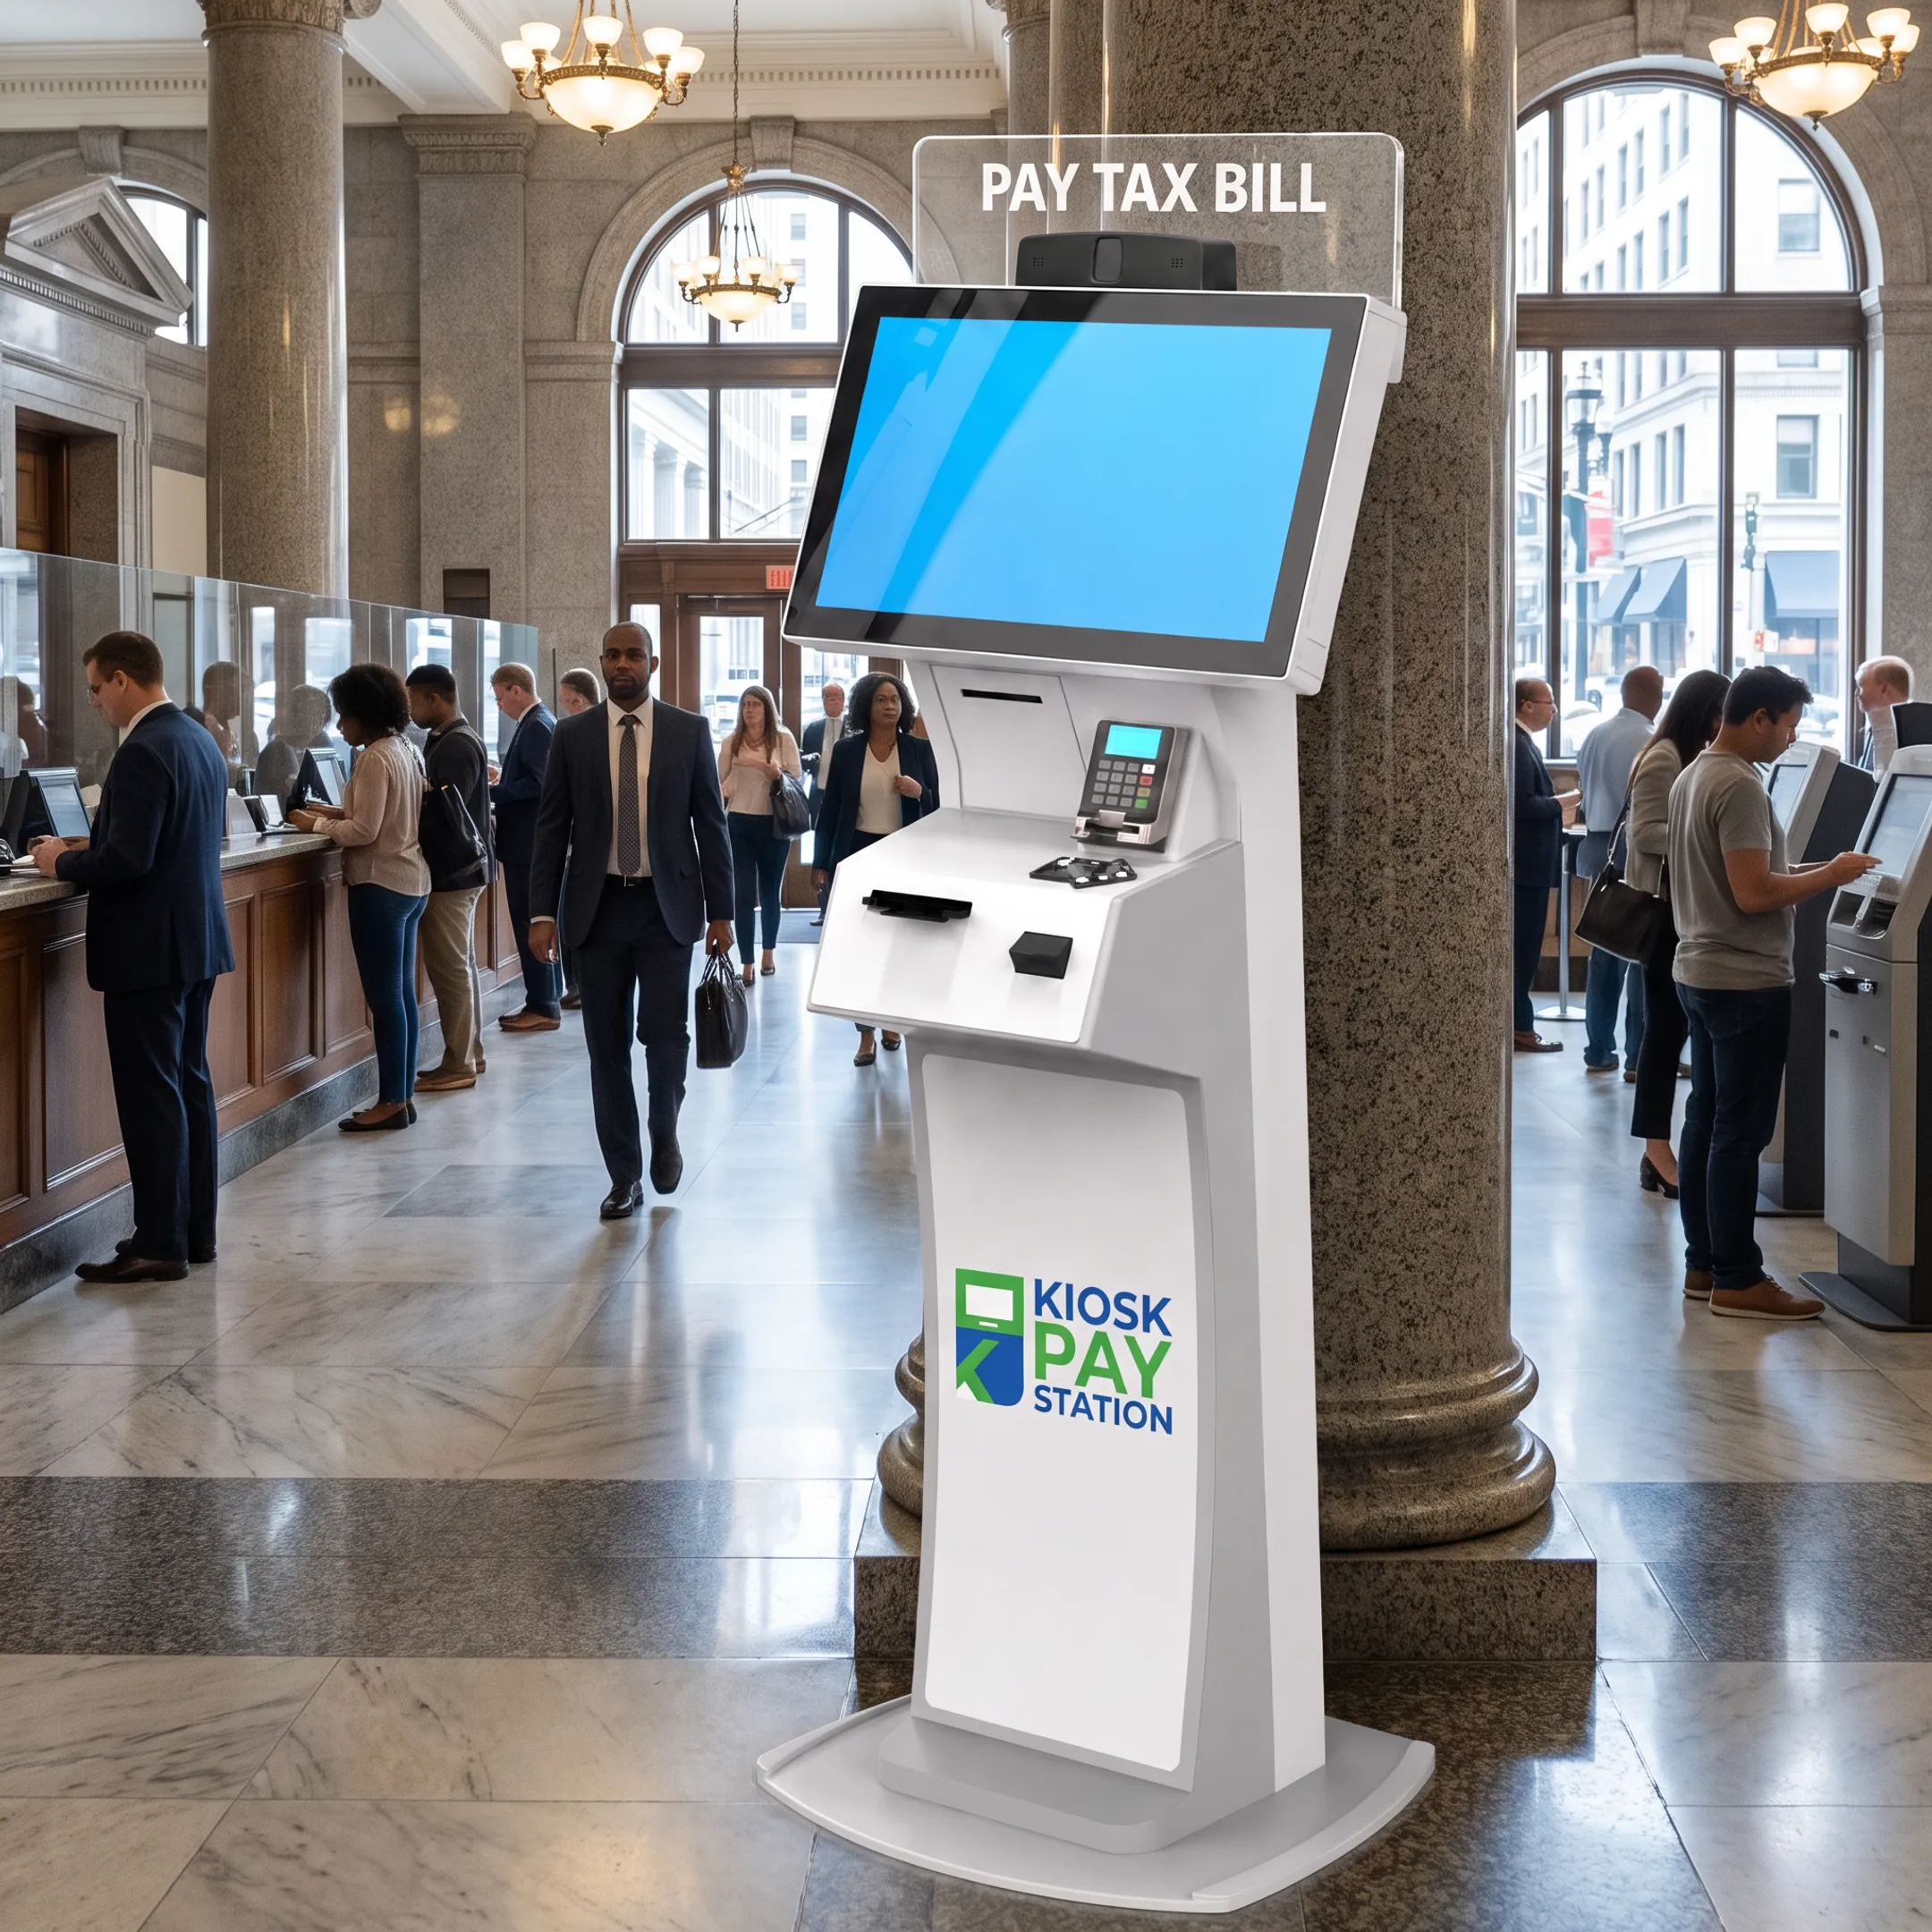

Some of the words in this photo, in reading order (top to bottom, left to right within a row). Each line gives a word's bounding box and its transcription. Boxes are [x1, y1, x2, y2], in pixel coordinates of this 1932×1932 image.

[982, 163, 1080, 211] PAY
[1093, 163, 1198, 212] TAX
[1215, 163, 1326, 213] BILL
[1034, 1278, 1173, 1336] KIOSK
[1035, 1321, 1172, 1398] PAY
[1034, 1385, 1173, 1435] STATION
